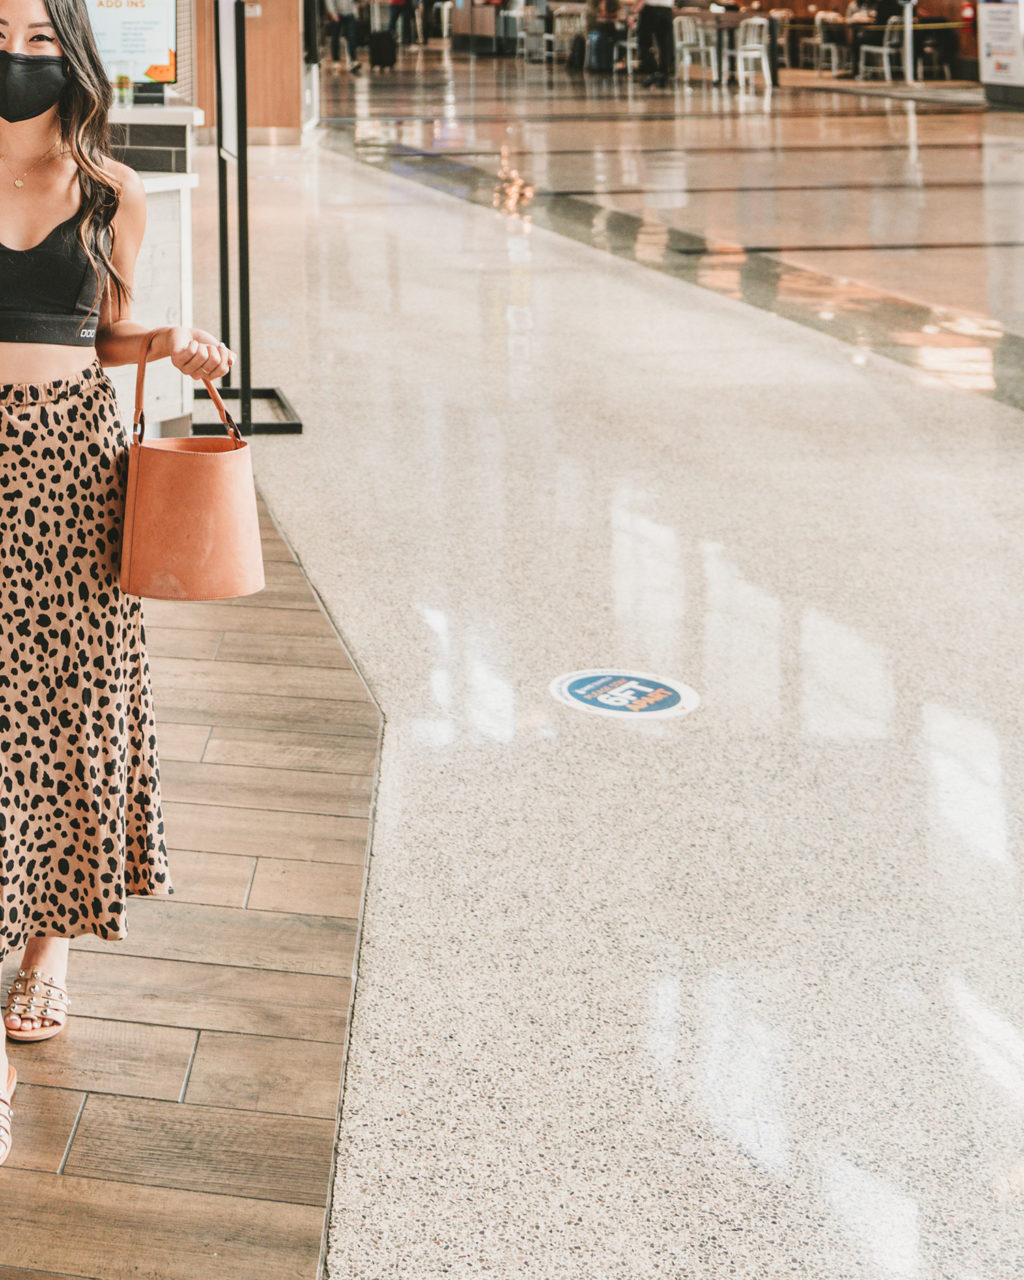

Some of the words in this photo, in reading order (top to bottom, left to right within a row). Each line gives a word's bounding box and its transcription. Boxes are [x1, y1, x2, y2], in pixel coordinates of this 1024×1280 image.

[97, 0, 122, 8] ADD
[127, 0, 146, 8] INS
[596, 680, 655, 706] 6FT
